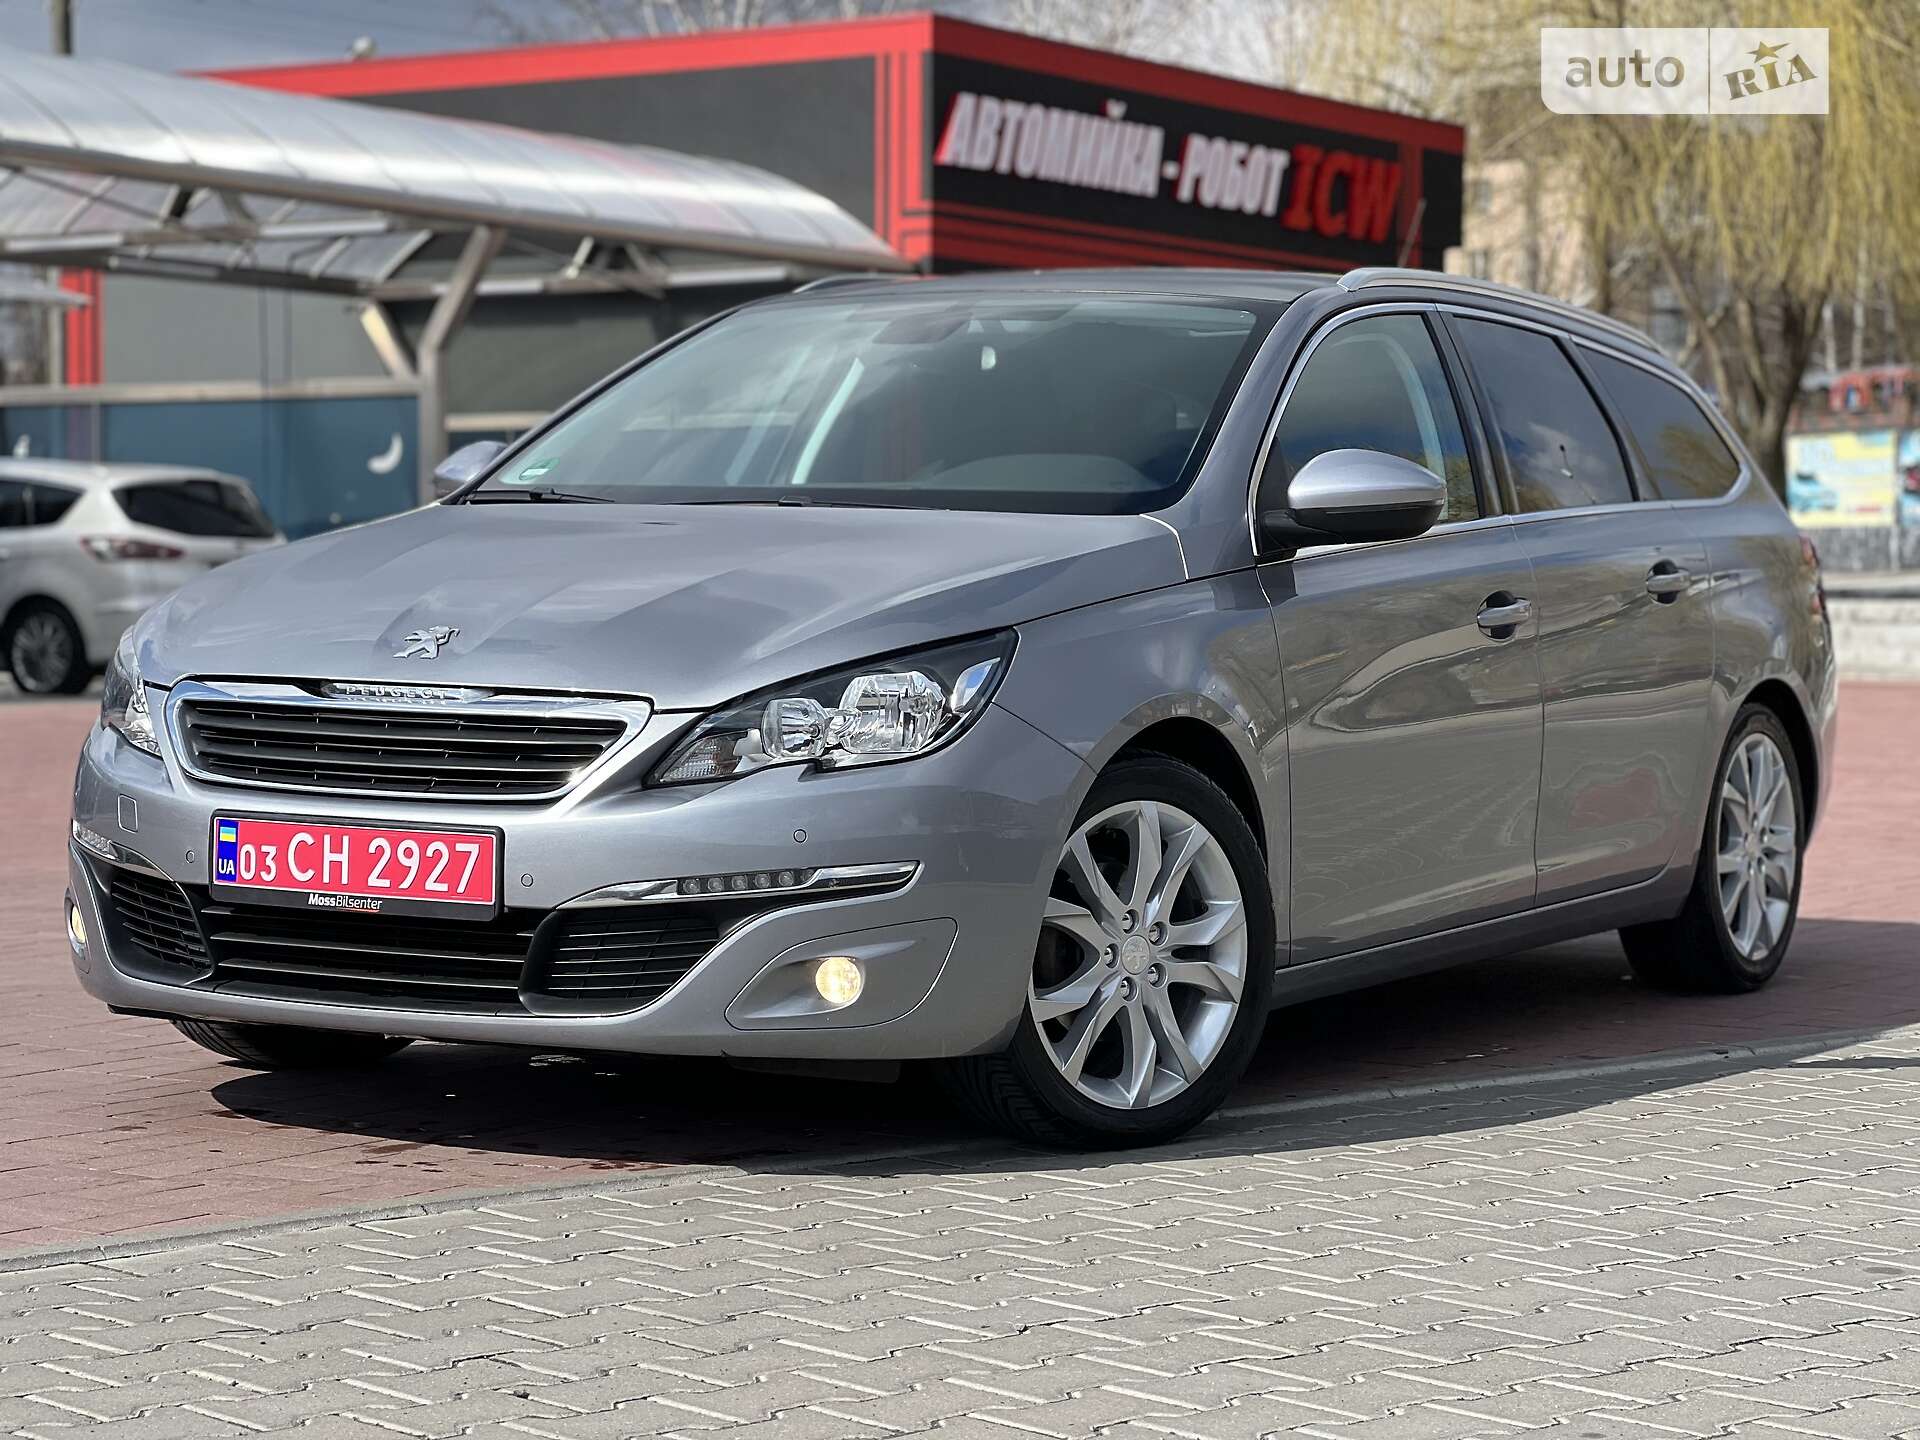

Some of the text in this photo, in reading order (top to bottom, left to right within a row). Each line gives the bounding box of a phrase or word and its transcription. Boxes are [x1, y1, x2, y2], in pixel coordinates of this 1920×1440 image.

[935, 91, 1165, 198] АВТОМИЙКА
[1175, 132, 1290, 217] РОБОТ
[1280, 143, 1400, 243] ICW
[346, 684, 448, 699] PEUGEOT
[218, 858, 235, 876] UA
[239, 832, 480, 894] 03 CH 2927
